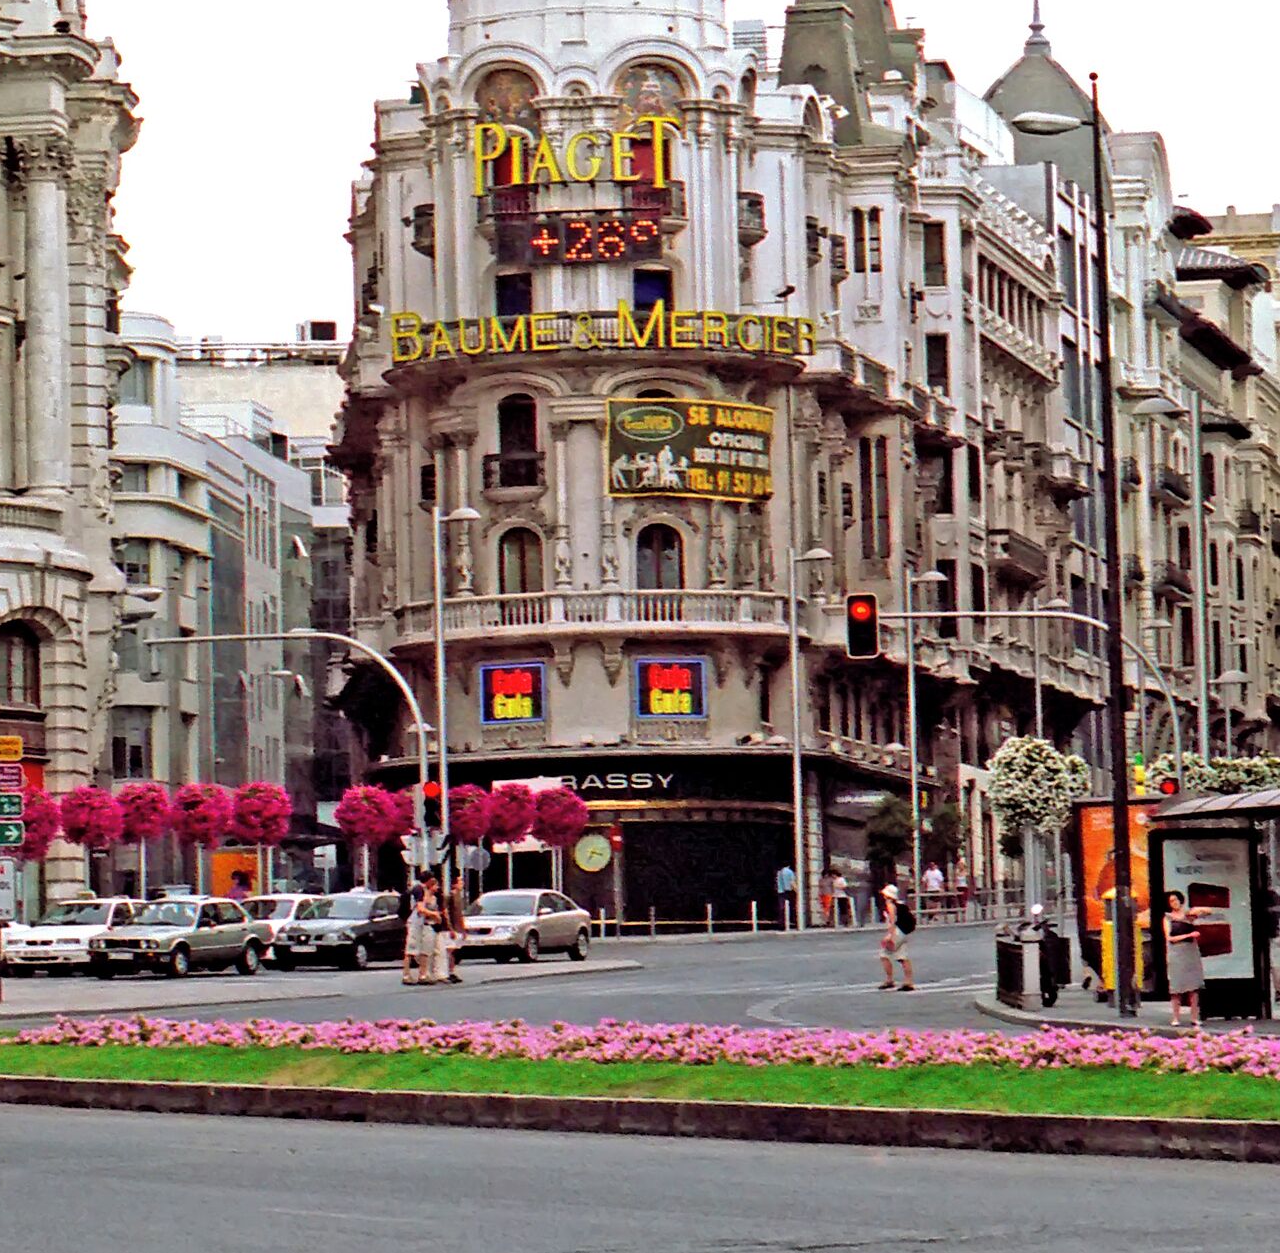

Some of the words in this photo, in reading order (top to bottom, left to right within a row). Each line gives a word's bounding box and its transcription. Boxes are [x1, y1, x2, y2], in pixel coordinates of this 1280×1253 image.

[473, 115, 681, 197] PIAGET
[391, 311, 560, 363] BAUME
[573, 313, 604, 350] &
[617, 299, 817, 356] MERCIER
[560, 773, 674, 790] RASSY
